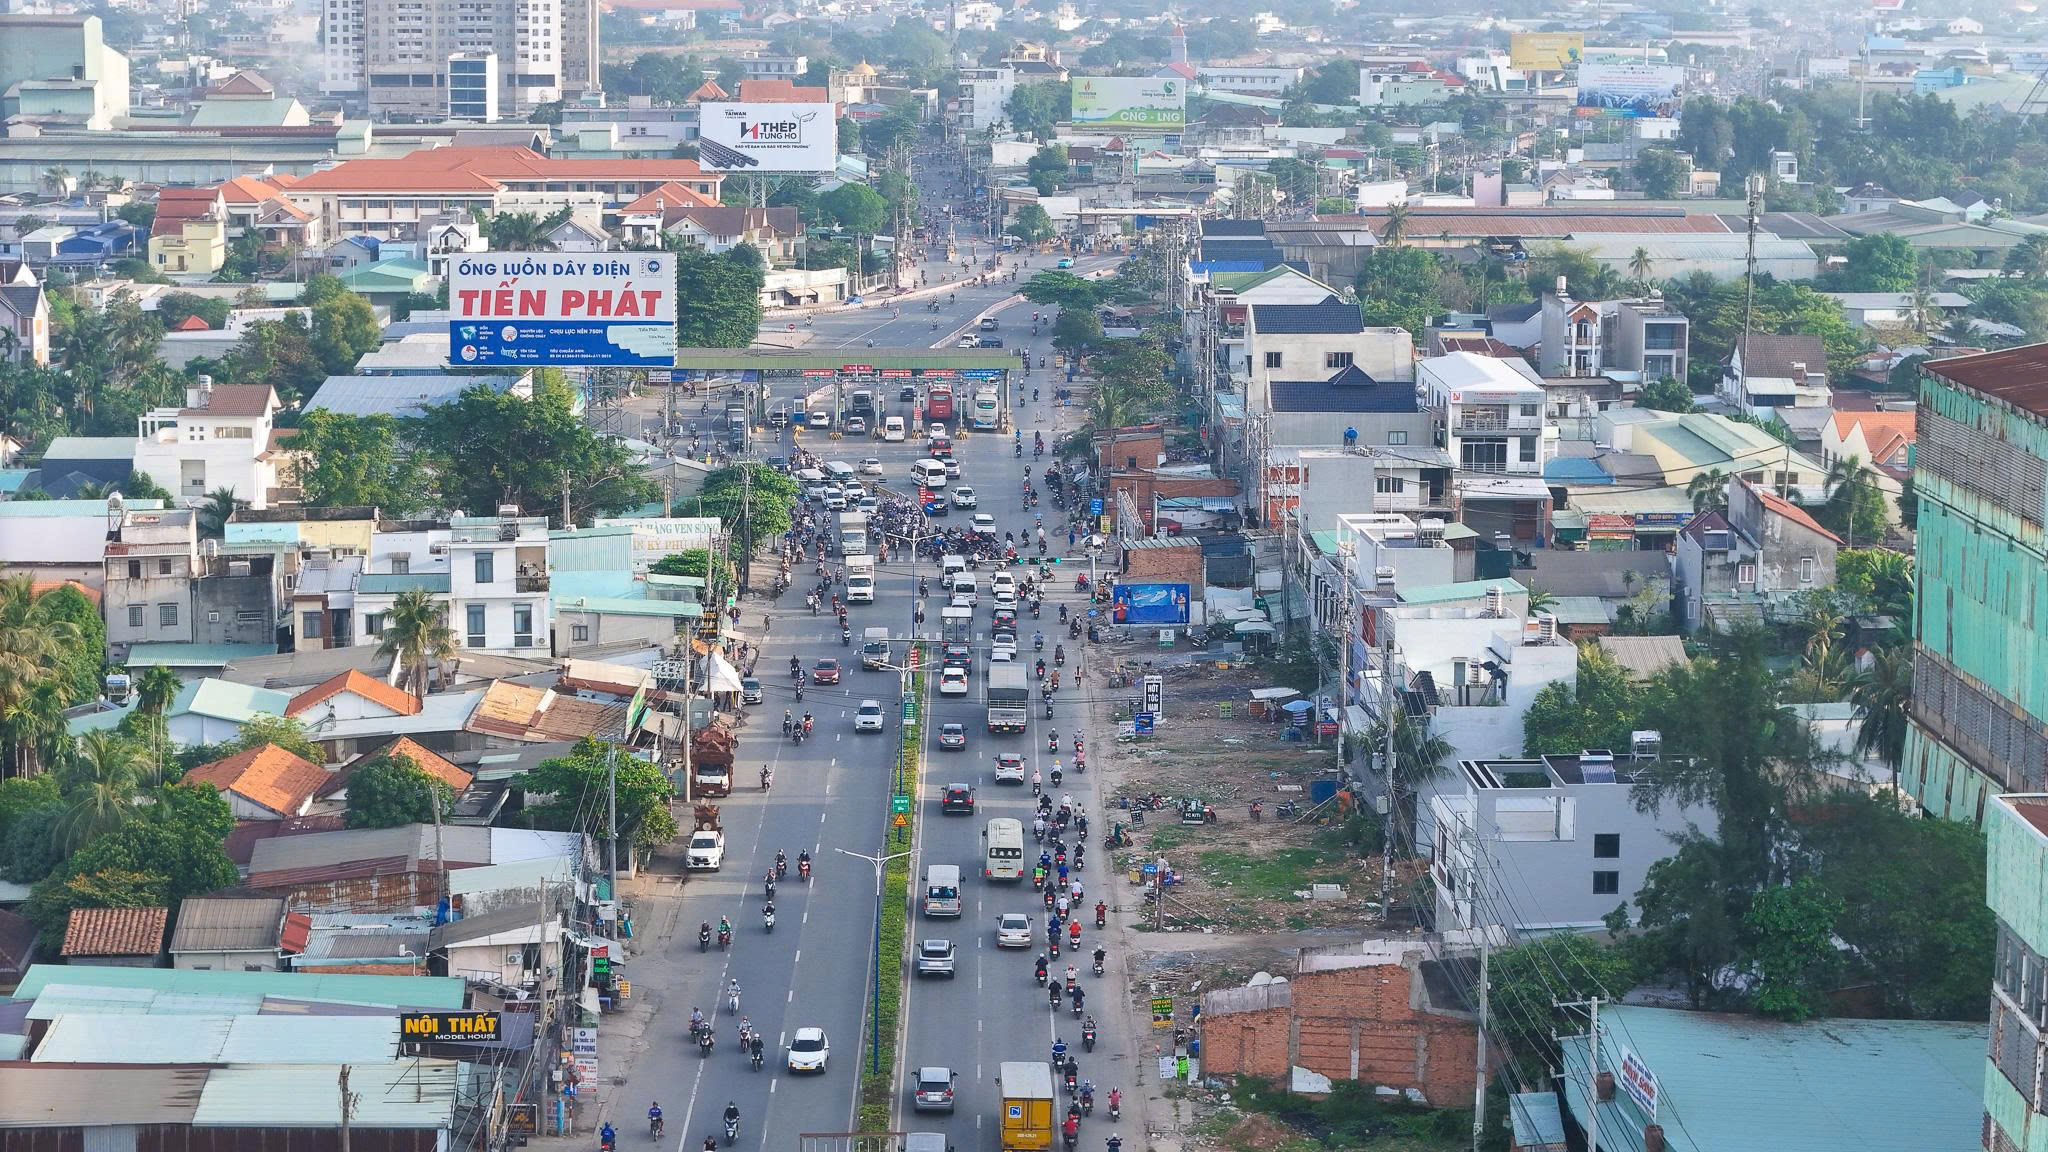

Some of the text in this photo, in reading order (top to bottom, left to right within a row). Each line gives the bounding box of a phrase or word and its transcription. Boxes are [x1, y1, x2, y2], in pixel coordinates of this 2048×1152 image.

[1120, 111, 1147, 121] CNG
[1157, 112, 1180, 122] LNG
[760, 120, 797, 133] THÉP
[760, 132, 783, 140] TUNG
[458, 258, 497, 276] ỐNG
[503, 257, 546, 276] LUỒN
[552, 259, 586, 276] DÂY
[592, 259, 630, 279] ĐIỆN
[458, 277, 662, 317] TIẾN PHÁT
[674, 523, 693, 534] VEN
[1147, 703, 1159, 711] NAM
[405, 1012, 497, 1038] NỘI THẤT
